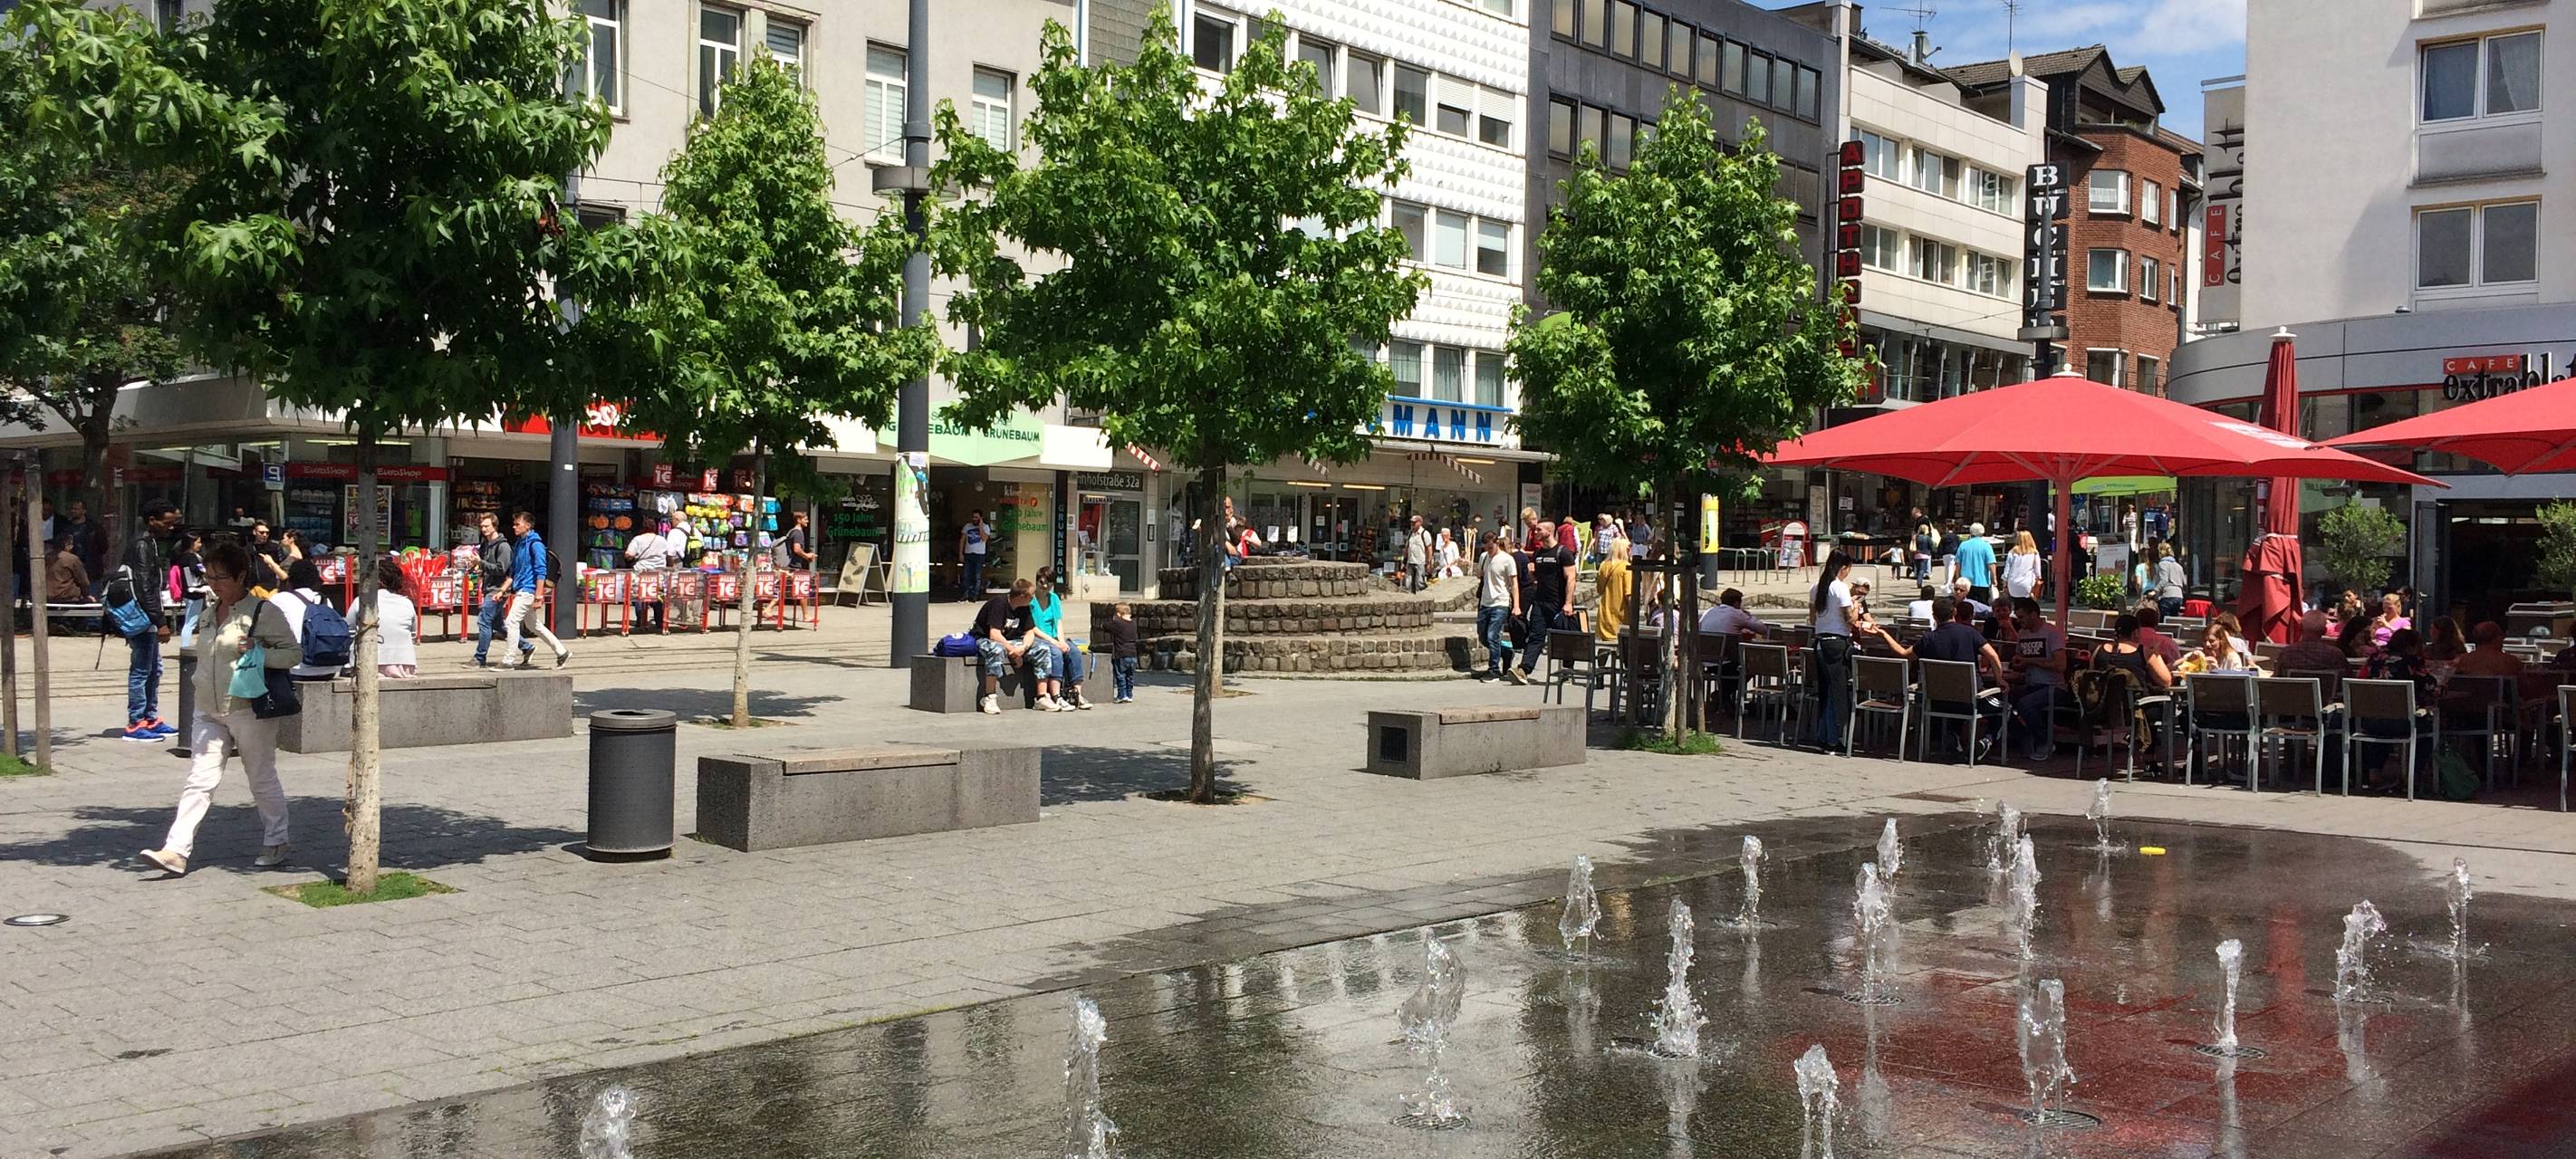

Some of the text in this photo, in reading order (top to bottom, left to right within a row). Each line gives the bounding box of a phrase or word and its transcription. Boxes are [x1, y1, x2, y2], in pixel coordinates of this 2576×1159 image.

[2208, 208, 2223, 283] CAFE
[2446, 358, 2514, 371] CAFE
[377, 467, 422, 479] EuroShop
[655, 470, 672, 484] 1€
[705, 474, 718, 486] 1€
[1125, 475, 1139, 488] 32a
[833, 512, 851, 522] 150
[316, 565, 335, 580] 1€
[597, 576, 615, 584] ALLES
[431, 586, 452, 604] 1€
[597, 583, 615, 599] 1€
[640, 582, 658, 598] 1€
[679, 582, 696, 597] 1€
[718, 581, 736, 597] 1€
[757, 581, 774, 596] 1€
[793, 581, 811, 595] 1€
